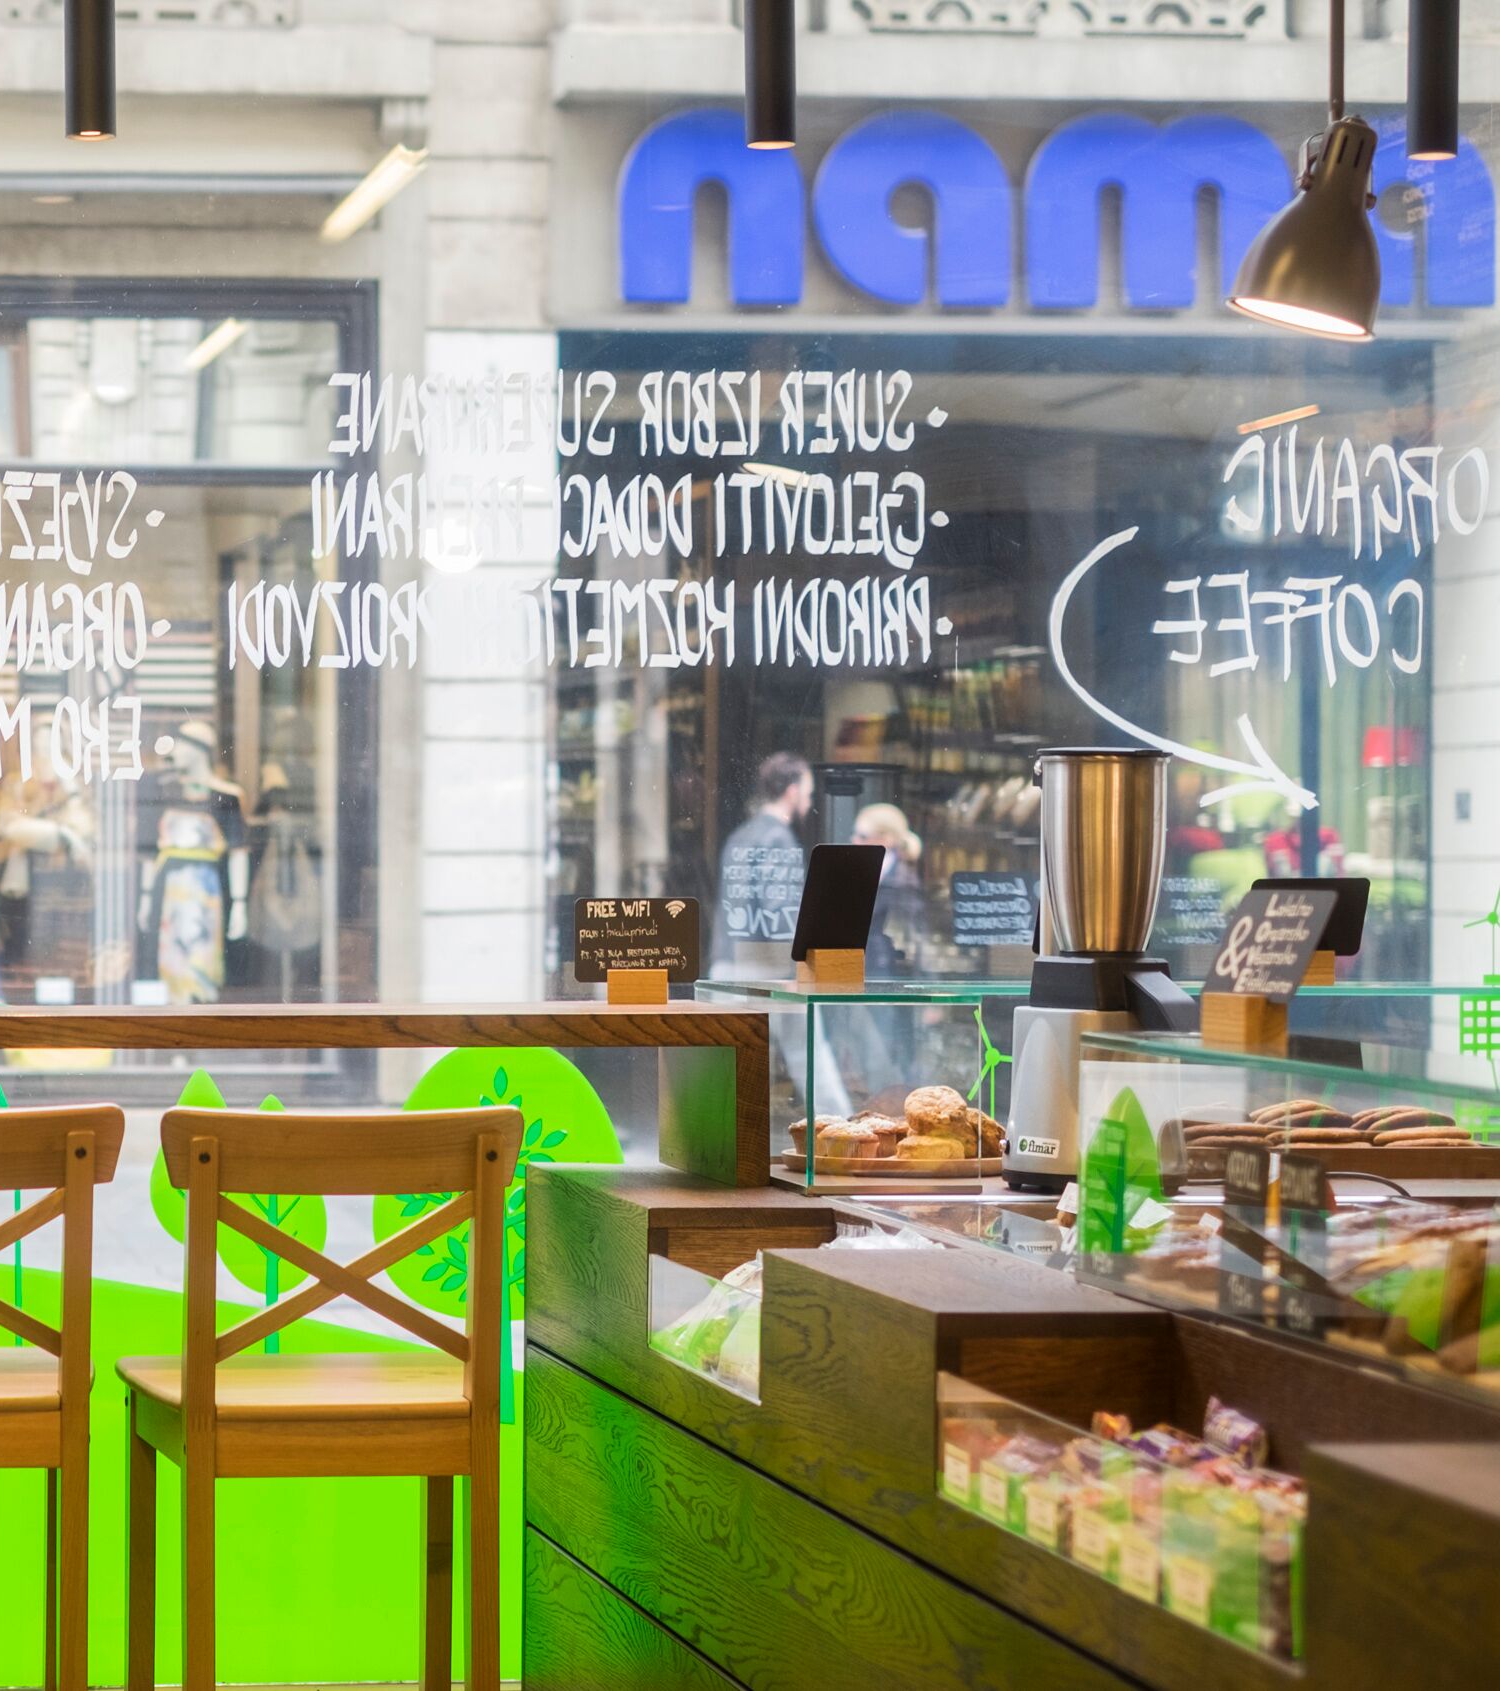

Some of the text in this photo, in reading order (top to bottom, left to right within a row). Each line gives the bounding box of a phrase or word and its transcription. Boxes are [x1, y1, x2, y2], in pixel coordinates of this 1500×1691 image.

[620, 109, 1496, 306] nama
[586, 900, 651, 919] FREE WIFI
[1028, 1139, 1056, 1155] fimar
